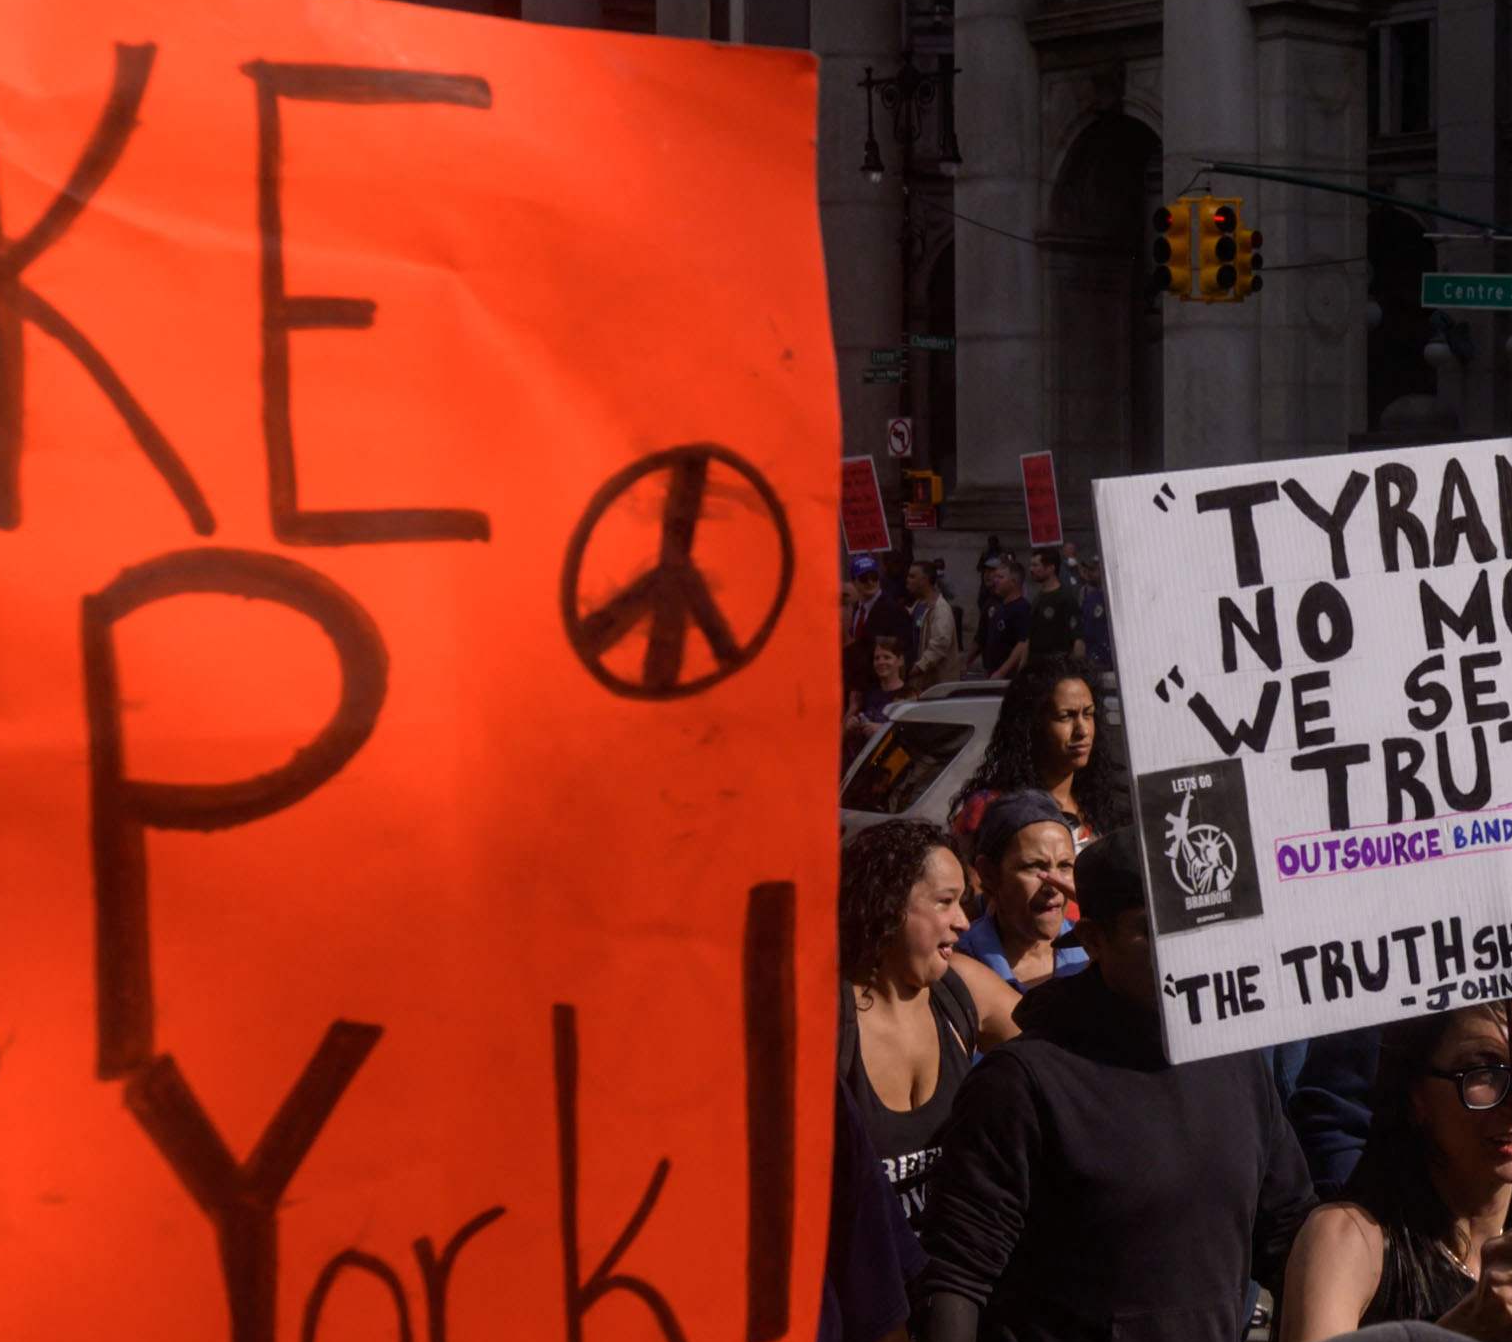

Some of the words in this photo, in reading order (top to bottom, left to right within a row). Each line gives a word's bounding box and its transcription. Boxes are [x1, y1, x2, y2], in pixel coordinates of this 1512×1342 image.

[1443, 281, 1506, 302] Centre
[1218, 581, 1354, 673] NO
[1155, 664, 1336, 757] "WE
[1277, 828, 1443, 877] OUTSOURCE
[1185, 889, 1232, 910] BRANDON!
[1280, 916, 1465, 1006] TRUTH
